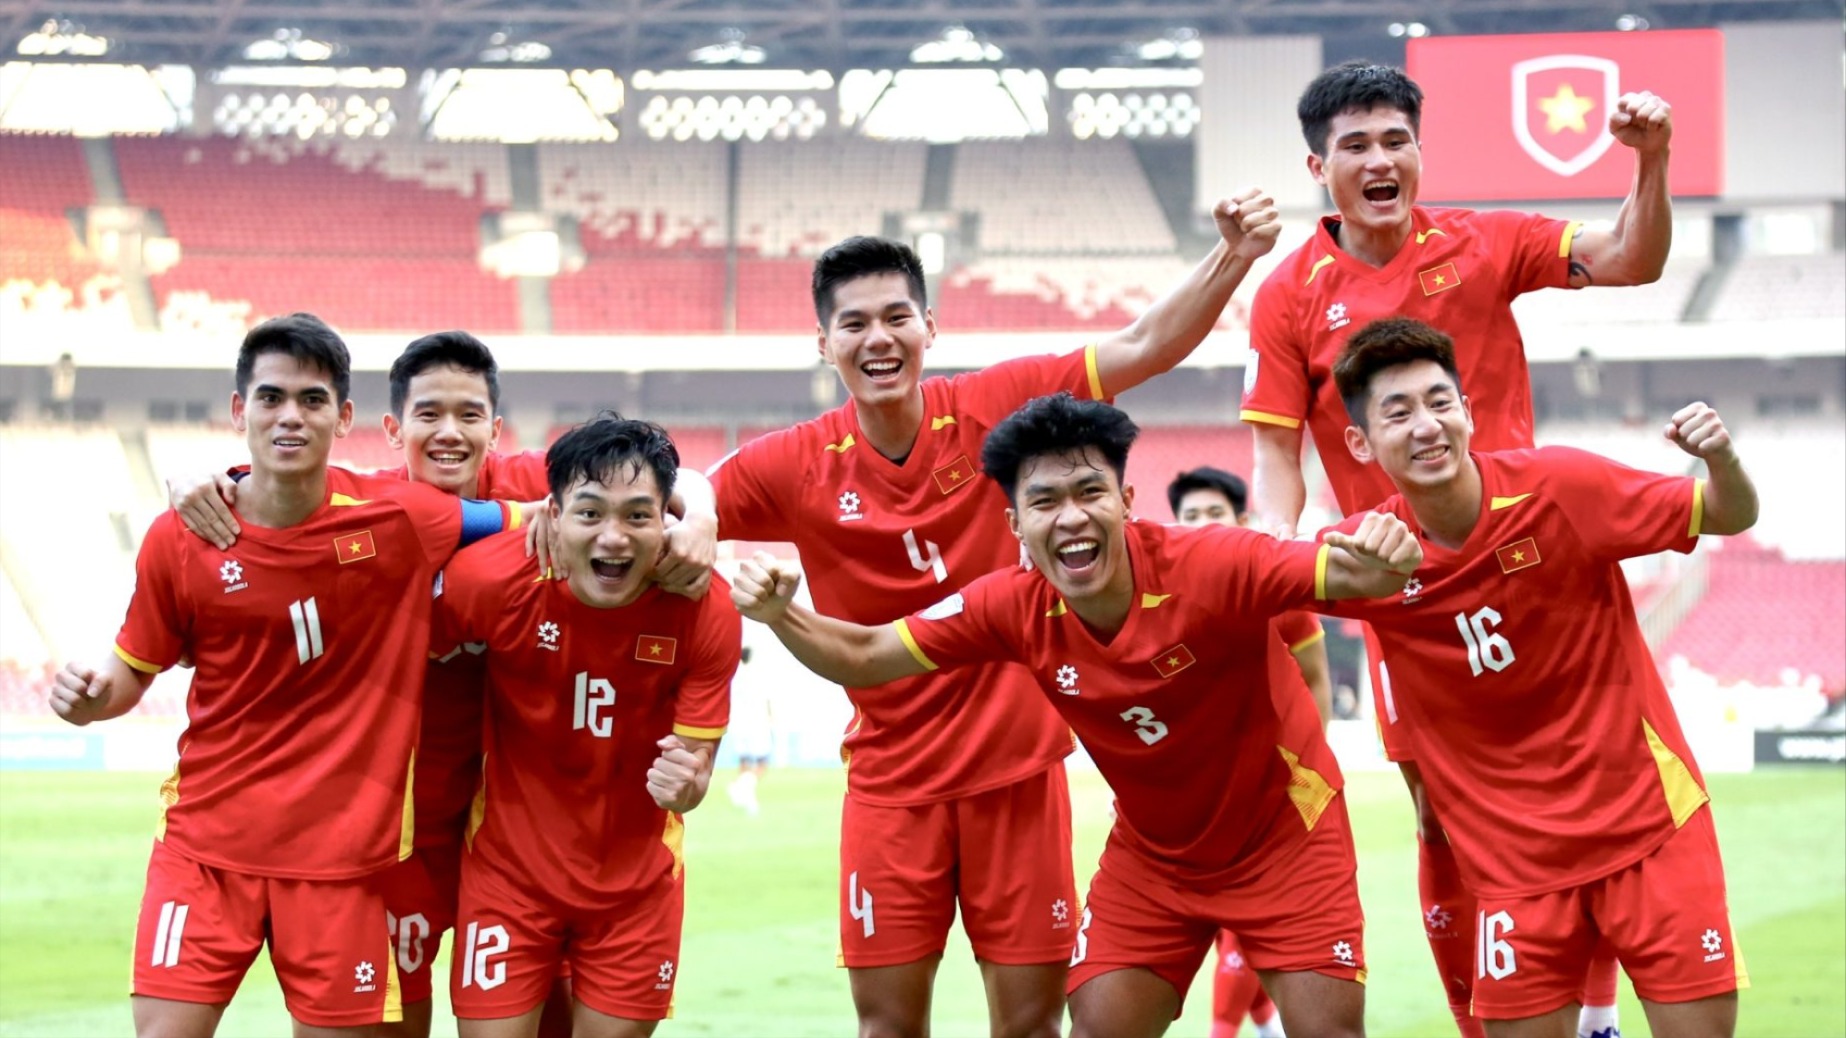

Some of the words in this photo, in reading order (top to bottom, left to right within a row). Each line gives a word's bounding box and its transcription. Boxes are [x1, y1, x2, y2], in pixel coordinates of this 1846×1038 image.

[903, 529, 947, 583] 4
[288, 597, 323, 665] 11
[1455, 606, 1516, 677] 16
[573, 671, 616, 737] 12
[1119, 706, 1169, 746] 3
[151, 901, 190, 969] 11
[848, 871, 875, 938] 4
[462, 921, 511, 991] 12
[1477, 909, 1517, 980] 16
